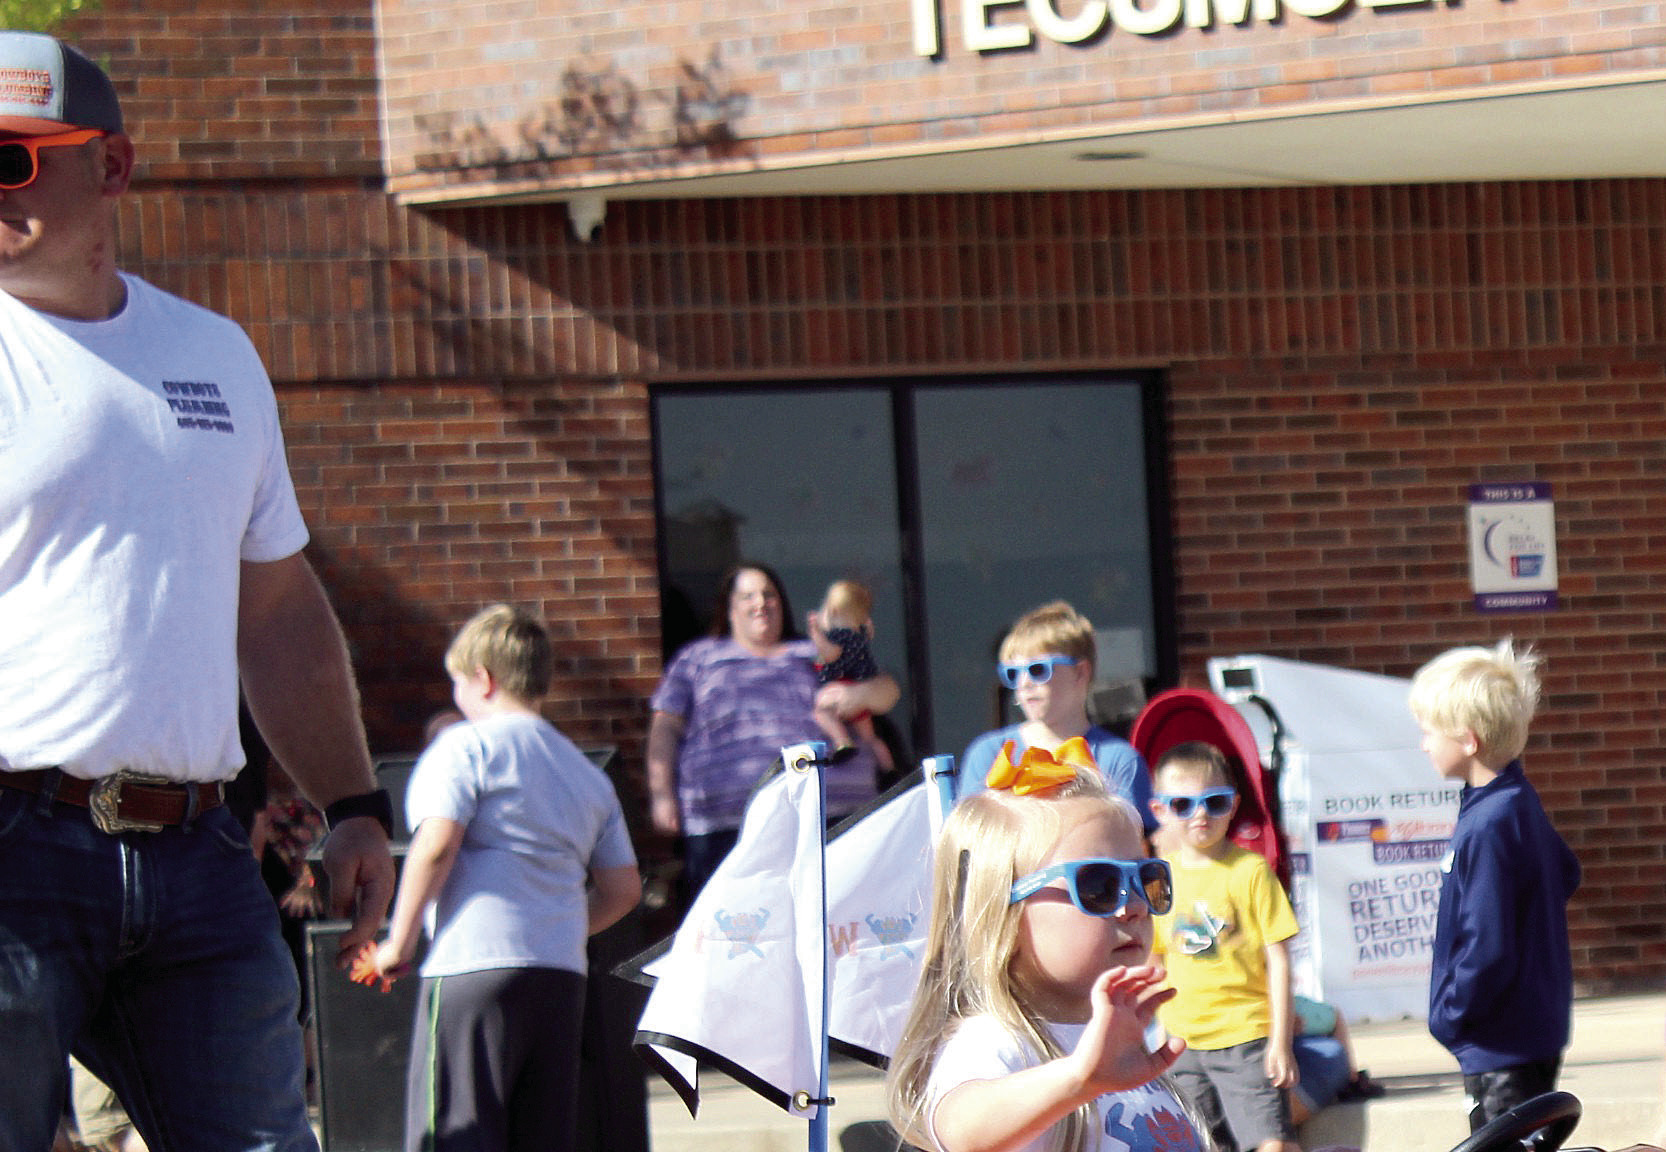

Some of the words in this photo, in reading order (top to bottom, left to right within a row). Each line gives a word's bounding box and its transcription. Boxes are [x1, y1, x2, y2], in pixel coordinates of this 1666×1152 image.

[1325, 794, 1383, 814] BOOK
[1390, 788, 1462, 808] RETUR
[1376, 845, 1413, 863] BOOK
[1349, 877, 1390, 899] ONE
[1394, 870, 1440, 890] GOO
[1351, 888, 1440, 921] RETUR
[1354, 913, 1436, 943] DESERV
[1359, 935, 1437, 961] ANOTH
